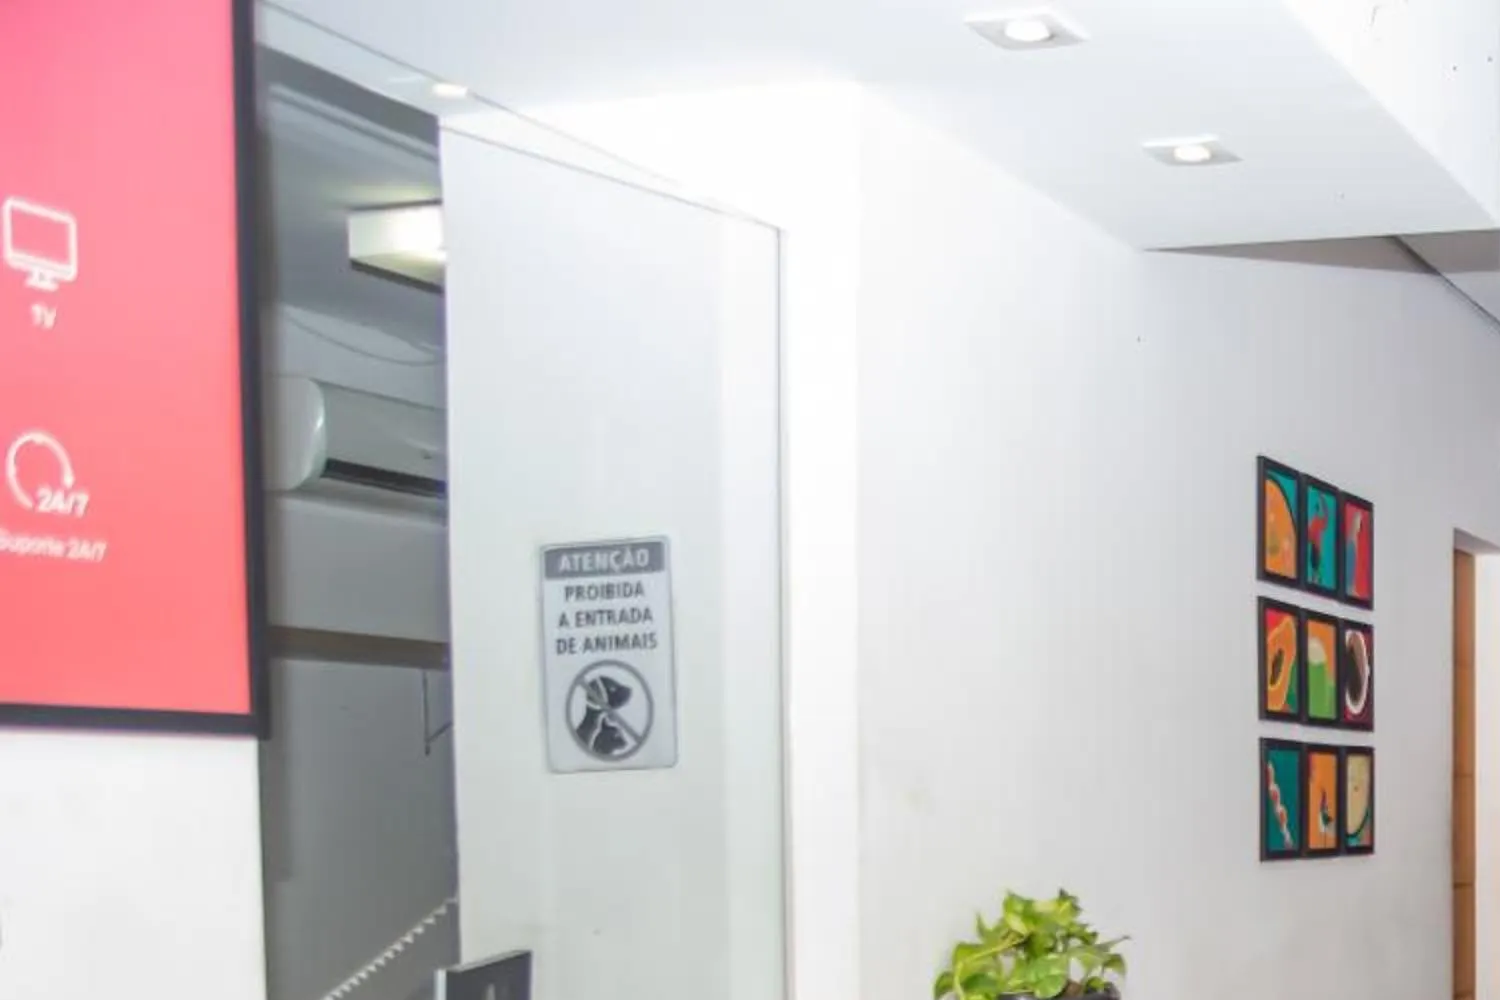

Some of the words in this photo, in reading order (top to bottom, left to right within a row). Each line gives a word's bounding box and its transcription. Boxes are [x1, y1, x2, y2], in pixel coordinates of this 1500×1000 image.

[30, 303, 57, 329] TV
[38, 486, 89, 517] 24/7
[67, 537, 107, 562] 24/7
[559, 547, 650, 572] ATENÇÃO
[564, 581, 644, 601] PROIBIDA
[558, 611, 570, 628] A
[575, 607, 653, 627] ENTRADA
[556, 637, 577, 655] DE
[582, 632, 658, 653] ANIMAIS
